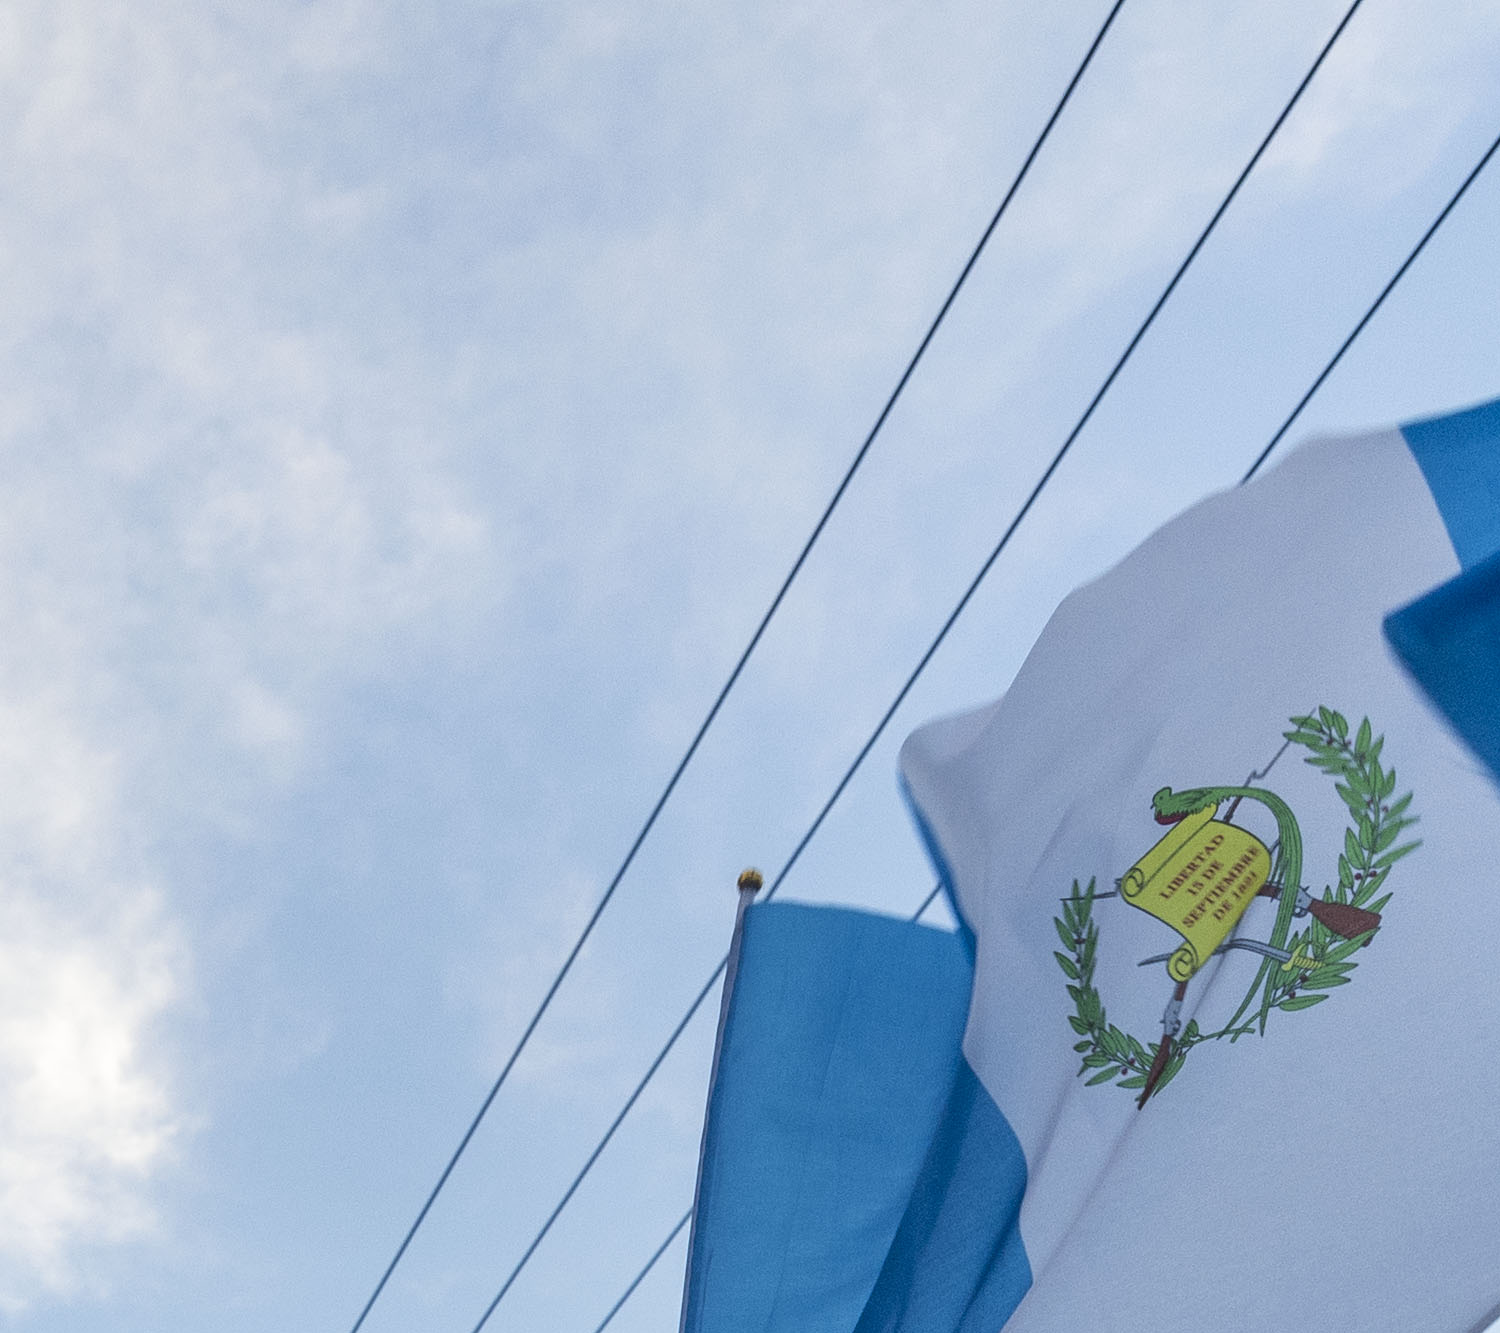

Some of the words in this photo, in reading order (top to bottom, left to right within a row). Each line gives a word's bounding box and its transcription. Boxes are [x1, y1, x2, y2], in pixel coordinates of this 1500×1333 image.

[1160, 834, 1225, 900] LIBERTAD
[1181, 846, 1260, 929] SEPTIEMBRE
[1187, 880, 1205, 896] 15
[1202, 859, 1225, 881] DE
[1212, 899, 1233, 921] DE
